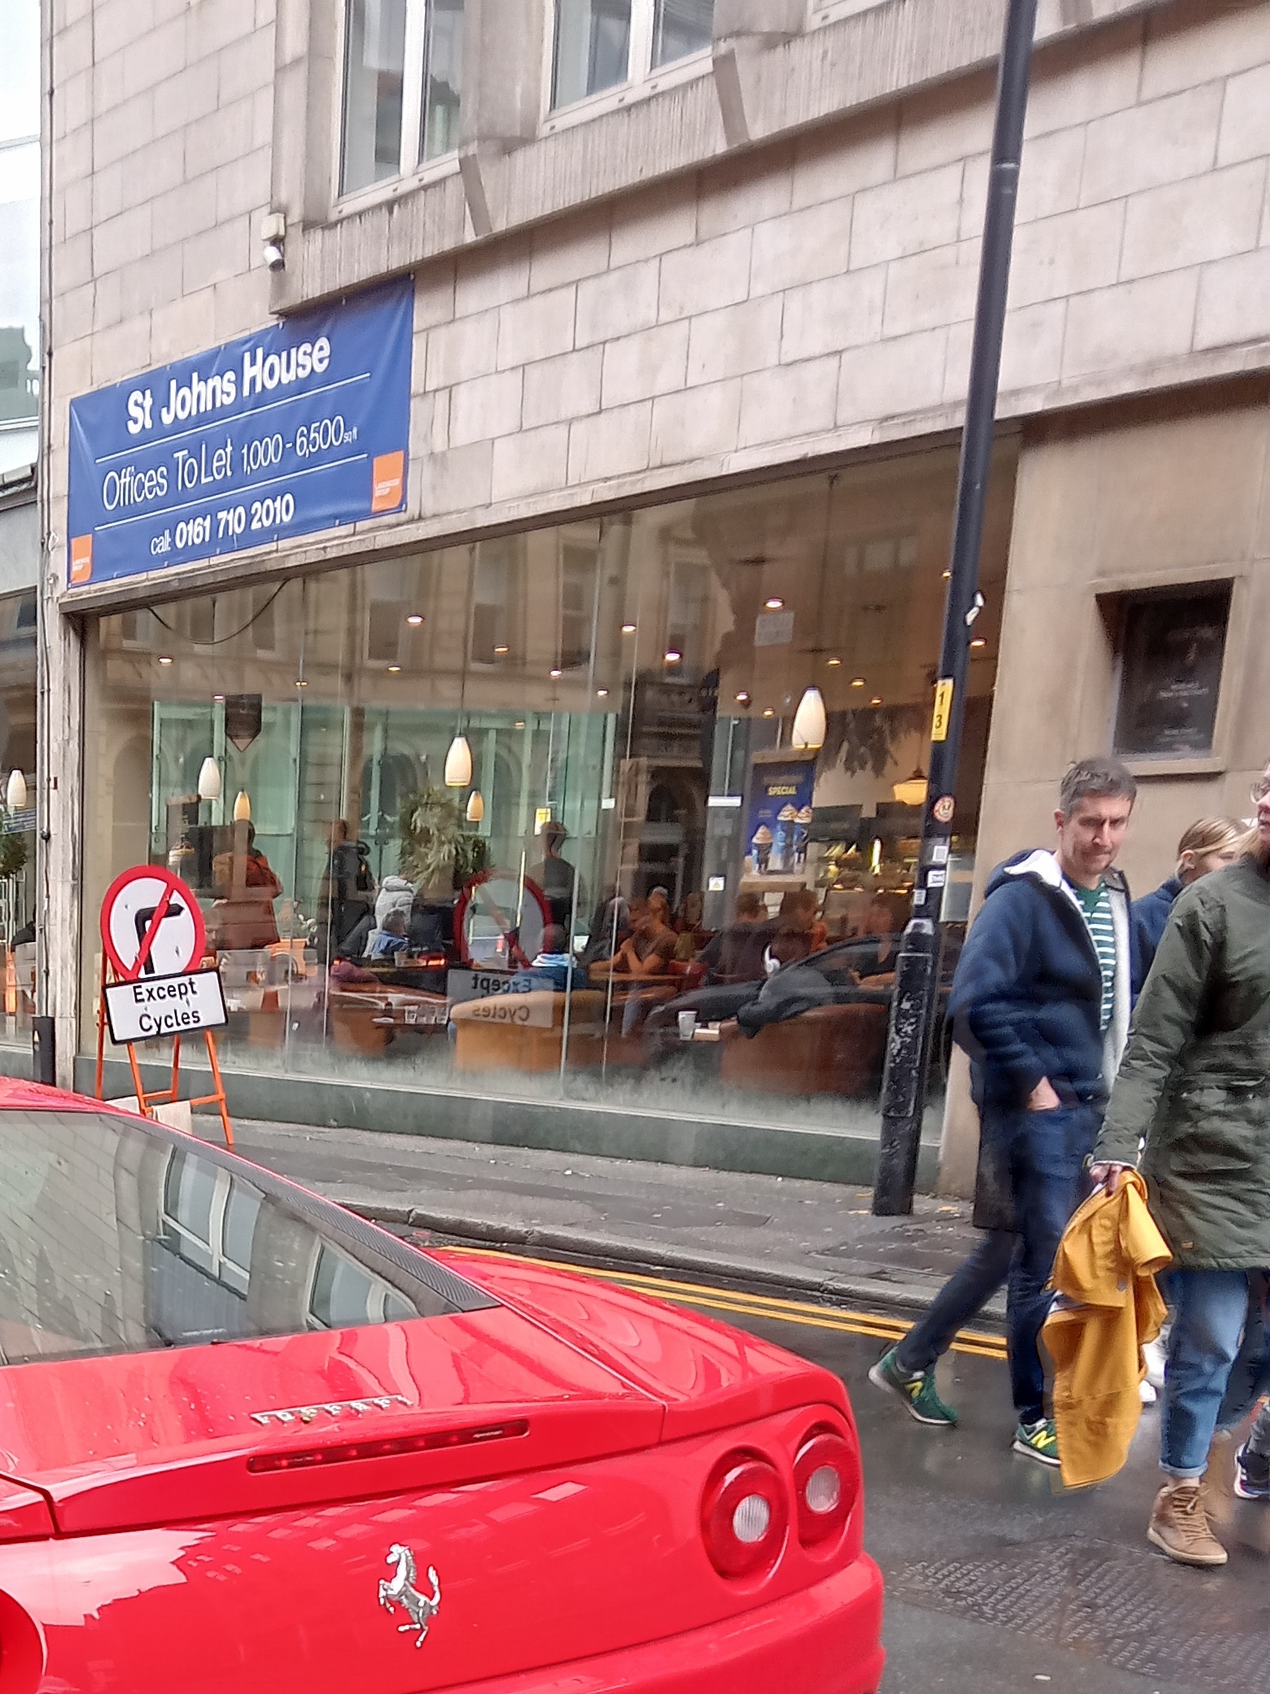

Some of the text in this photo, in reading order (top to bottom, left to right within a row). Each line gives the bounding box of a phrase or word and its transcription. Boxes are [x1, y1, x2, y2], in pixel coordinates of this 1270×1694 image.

[127, 336, 330, 434] St Johns House
[102, 465, 168, 511] Offices
[173, 449, 198, 490] To
[200, 437, 233, 484] Let
[241, 433, 283, 475] 1,000
[175, 514, 211, 549] 0161
[217, 505, 247, 539] 710
[251, 493, 295, 531] 2010
[133, 977, 198, 1004] Except
[138, 1008, 201, 1036] Cycles
